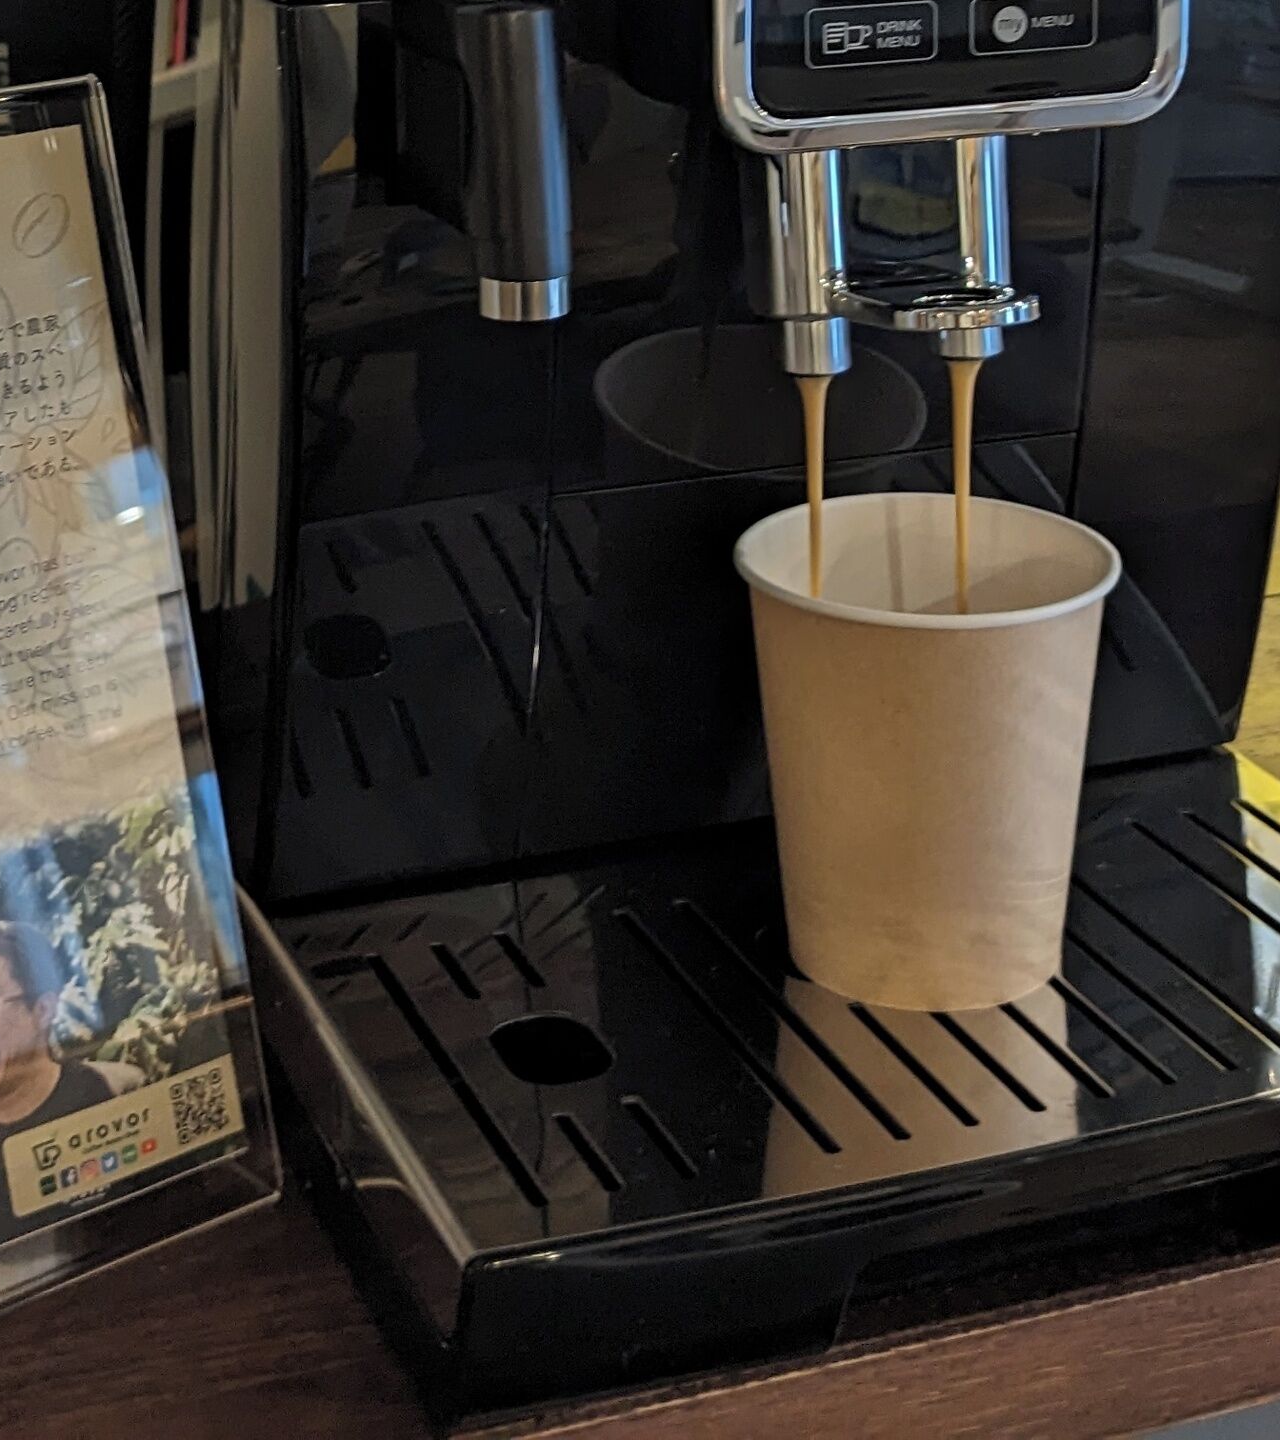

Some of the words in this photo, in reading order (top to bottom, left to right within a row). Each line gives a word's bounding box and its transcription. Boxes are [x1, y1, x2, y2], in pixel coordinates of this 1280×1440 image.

[875, 18, 923, 34] DRINK
[1031, 14, 1075, 28] MENU
[875, 35, 921, 49] MENU
[67, 1108, 151, 1149] arovor
